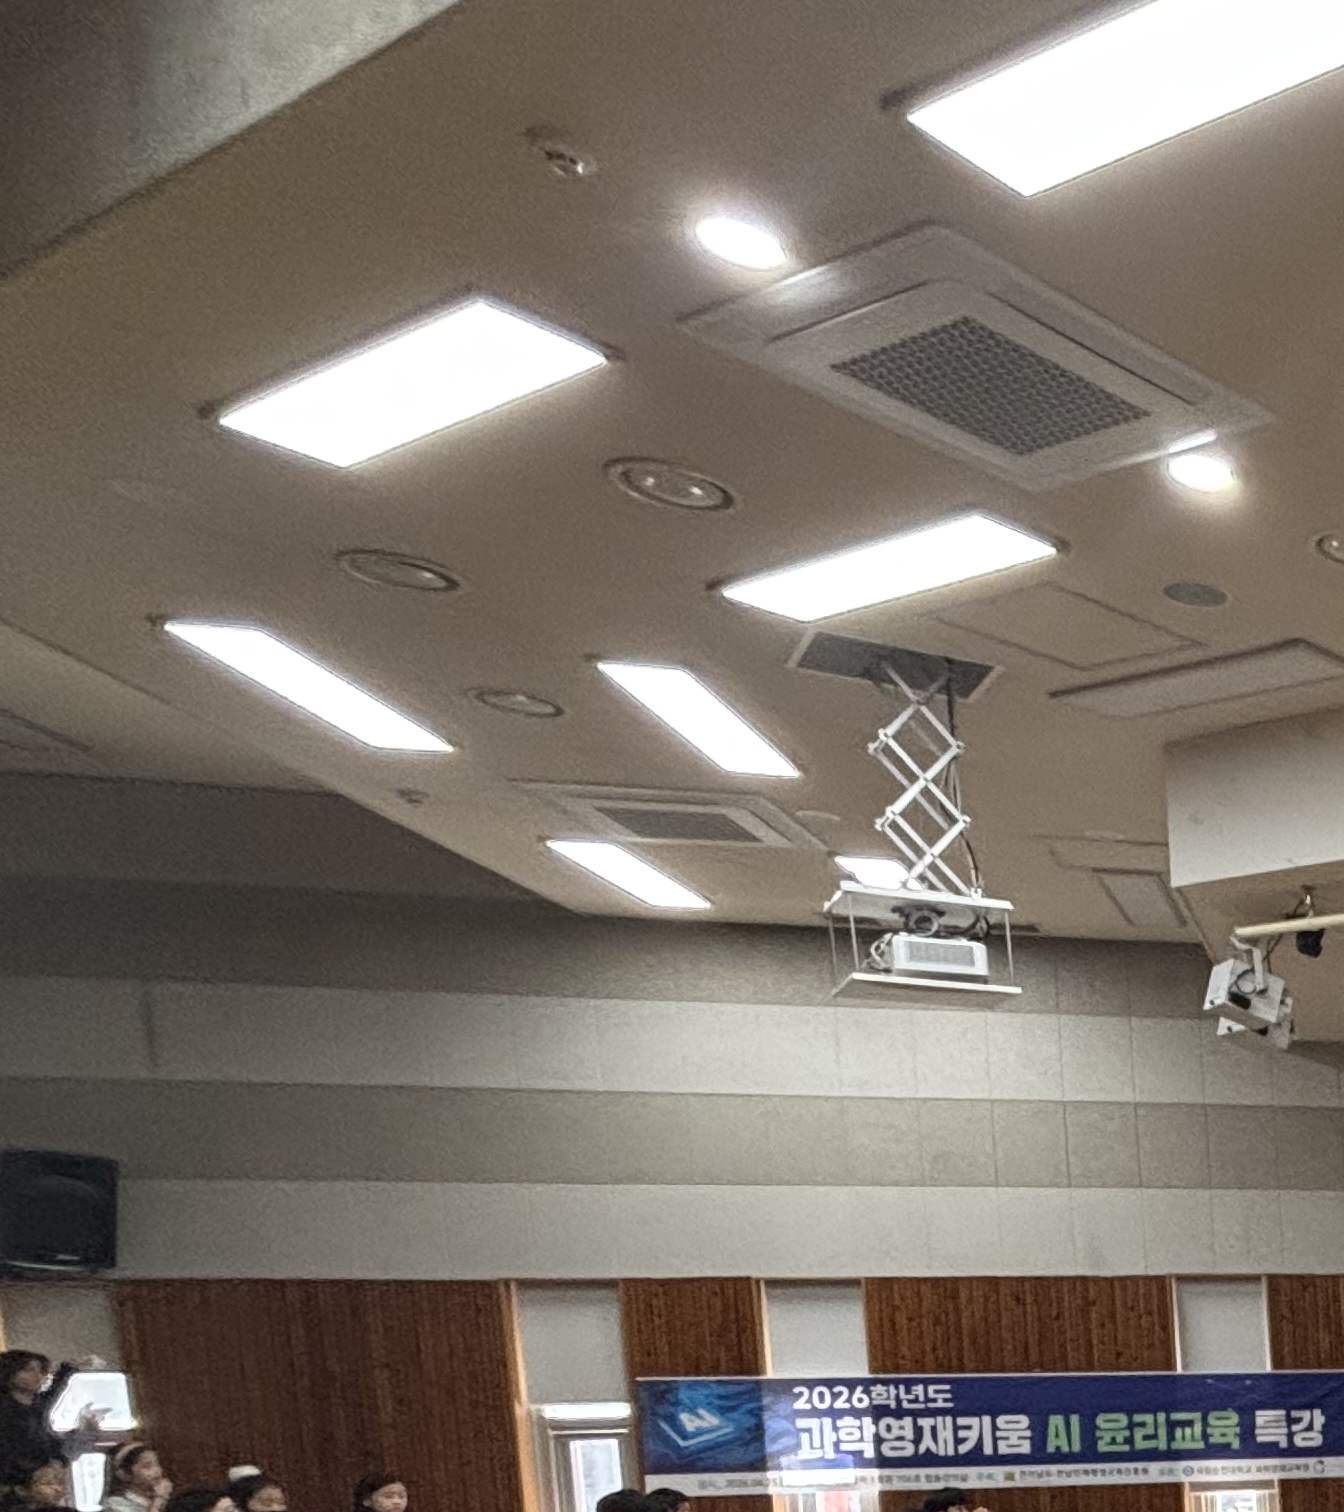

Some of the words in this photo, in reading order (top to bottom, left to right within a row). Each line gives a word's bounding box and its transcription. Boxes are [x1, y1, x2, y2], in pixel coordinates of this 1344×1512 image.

[792, 1384, 955, 1410] 2026학년도
[794, 1413, 1032, 1460] 과학영재키움
[1046, 1413, 1082, 1453] AI
[1095, 1407, 1241, 1453] 윤리교육
[1254, 1407, 1326, 1449] 특강
